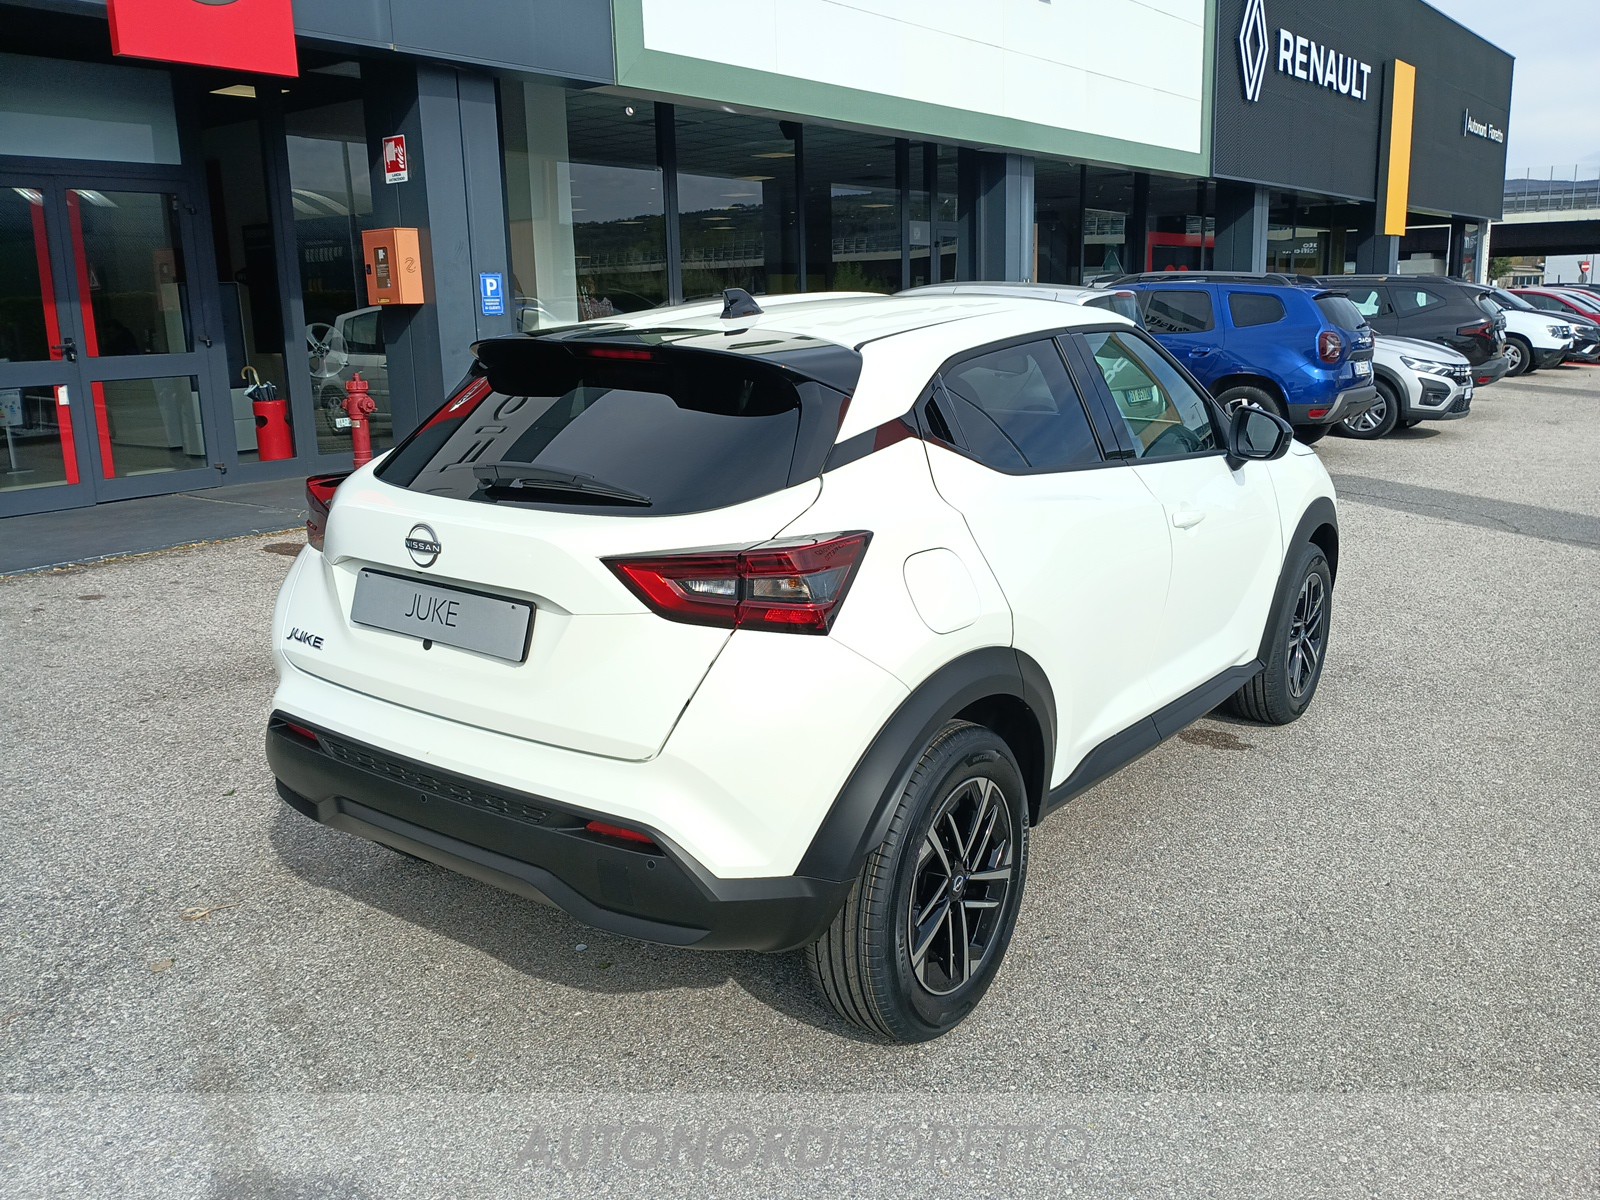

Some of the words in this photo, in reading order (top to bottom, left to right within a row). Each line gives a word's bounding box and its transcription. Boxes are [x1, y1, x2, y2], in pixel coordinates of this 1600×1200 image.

[1279, 28, 1371, 100] RENAULT
[1468, 116, 1487, 138] Autonord
[486, 278, 498, 297] P
[405, 539, 440, 553] NISSAN
[405, 593, 460, 628] JUKE
[286, 627, 324, 650] JUKE
